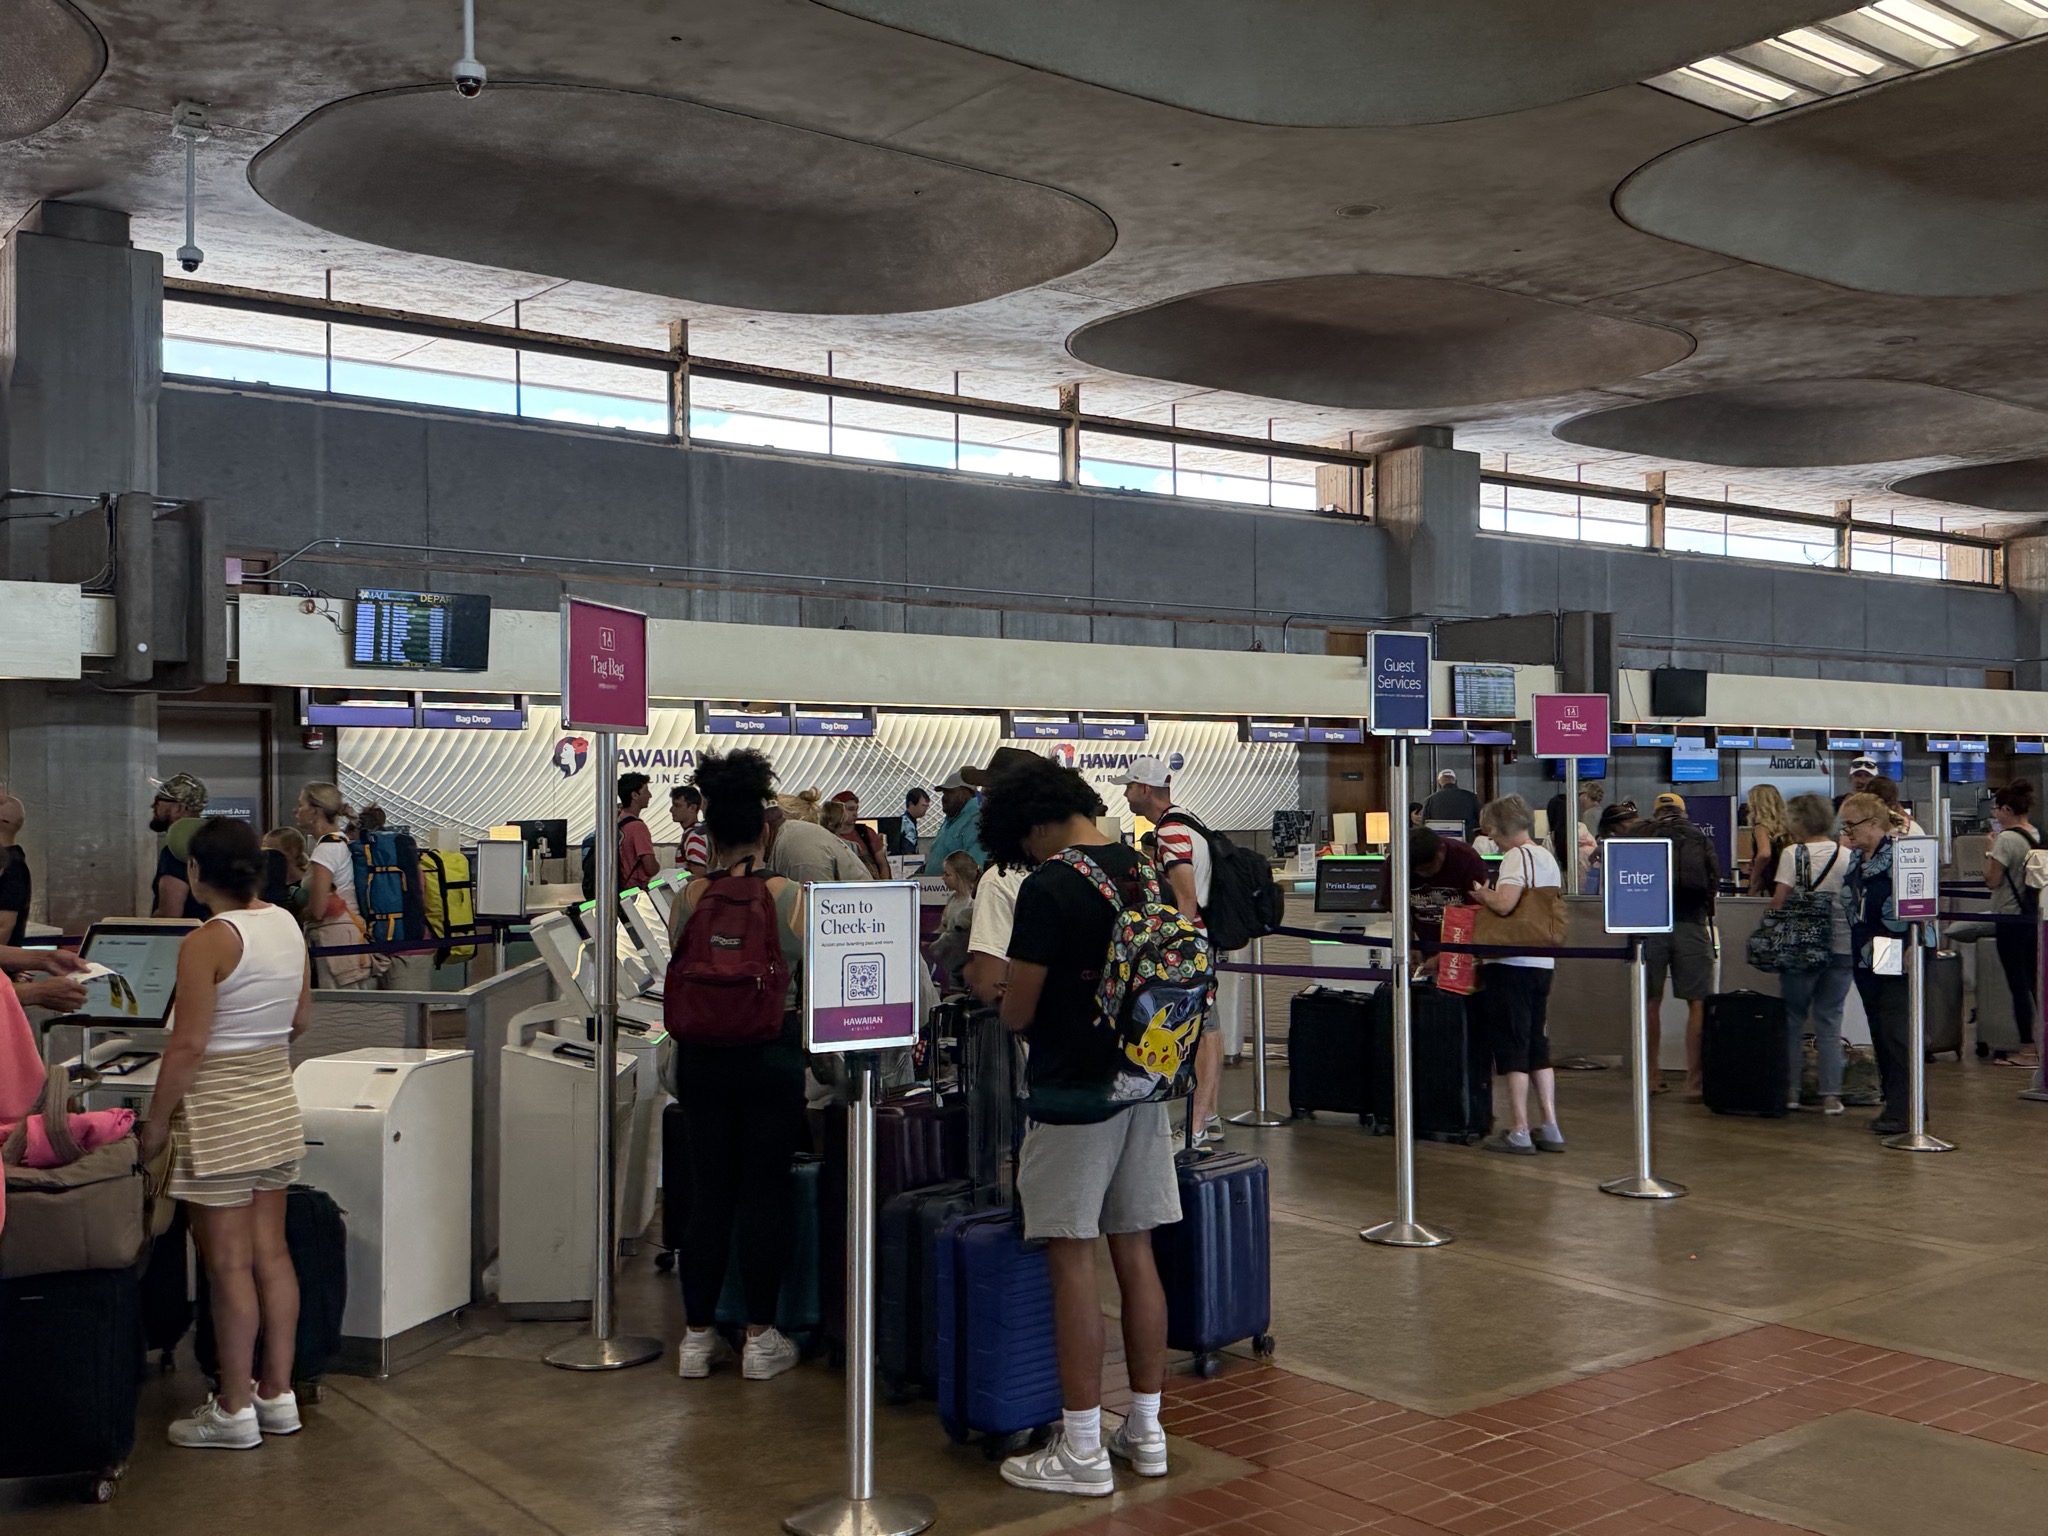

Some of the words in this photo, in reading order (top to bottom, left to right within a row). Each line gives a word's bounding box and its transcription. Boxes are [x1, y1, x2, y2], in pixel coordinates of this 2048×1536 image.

[590, 654, 608, 678] Tag
[608, 658, 624, 680] Bag
[1384, 658, 1415, 672] Guest
[1378, 674, 1422, 690] Services
[456, 714, 470, 724] Bag
[472, 714, 491, 724] Drop
[736, 720, 748, 730] Bag
[750, 720, 764, 730] Drop
[821, 722, 834, 731] Bag
[835, 722, 848, 732] Drop
[1036, 726, 1046, 735] Bag
[1046, 727, 1058, 735] Drop
[1103, 728, 1112, 736] Bag
[1113, 728, 1126, 736] Drop
[1556, 720, 1571, 732] Tag
[1572, 720, 1587, 732] Bag
[1769, 755, 1816, 770] American
[1620, 870, 1654, 884] Enter
[820, 899, 856, 915] Scan
[859, 902, 873, 914] to
[821, 918, 886, 935] Check-in
[844, 1016, 883, 1026] HAWAIIAN
